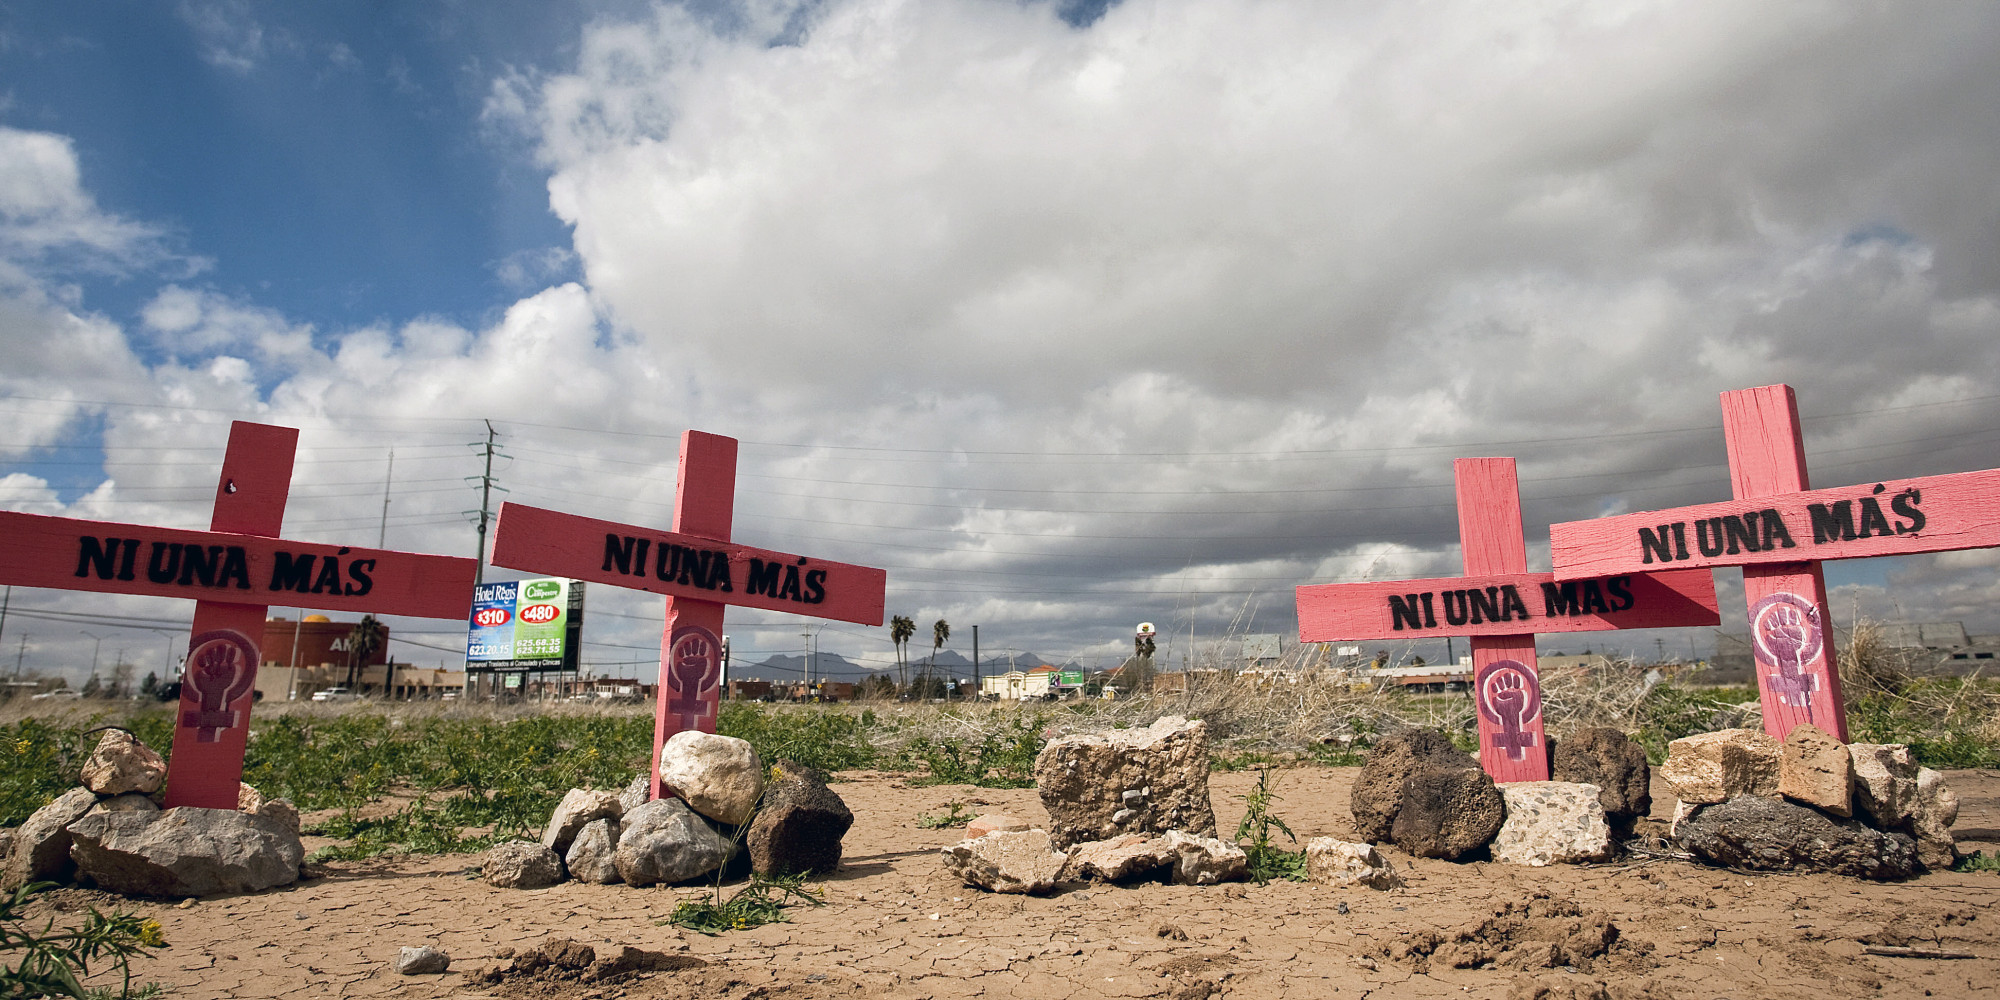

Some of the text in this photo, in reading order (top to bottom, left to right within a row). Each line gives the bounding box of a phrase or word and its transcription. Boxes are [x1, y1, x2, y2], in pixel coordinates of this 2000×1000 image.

[1638, 483, 1926, 564] NI UNA MÁS
[74, 535, 376, 596] NI UNA MÁS
[601, 533, 827, 604] NI UNA MÁS
[474, 585, 495, 602] Hotel
[477, 610, 504, 624] $310
[524, 605, 554, 620] $480
[1388, 593, 1437, 631] NI
[1441, 584, 1531, 626] UNA
